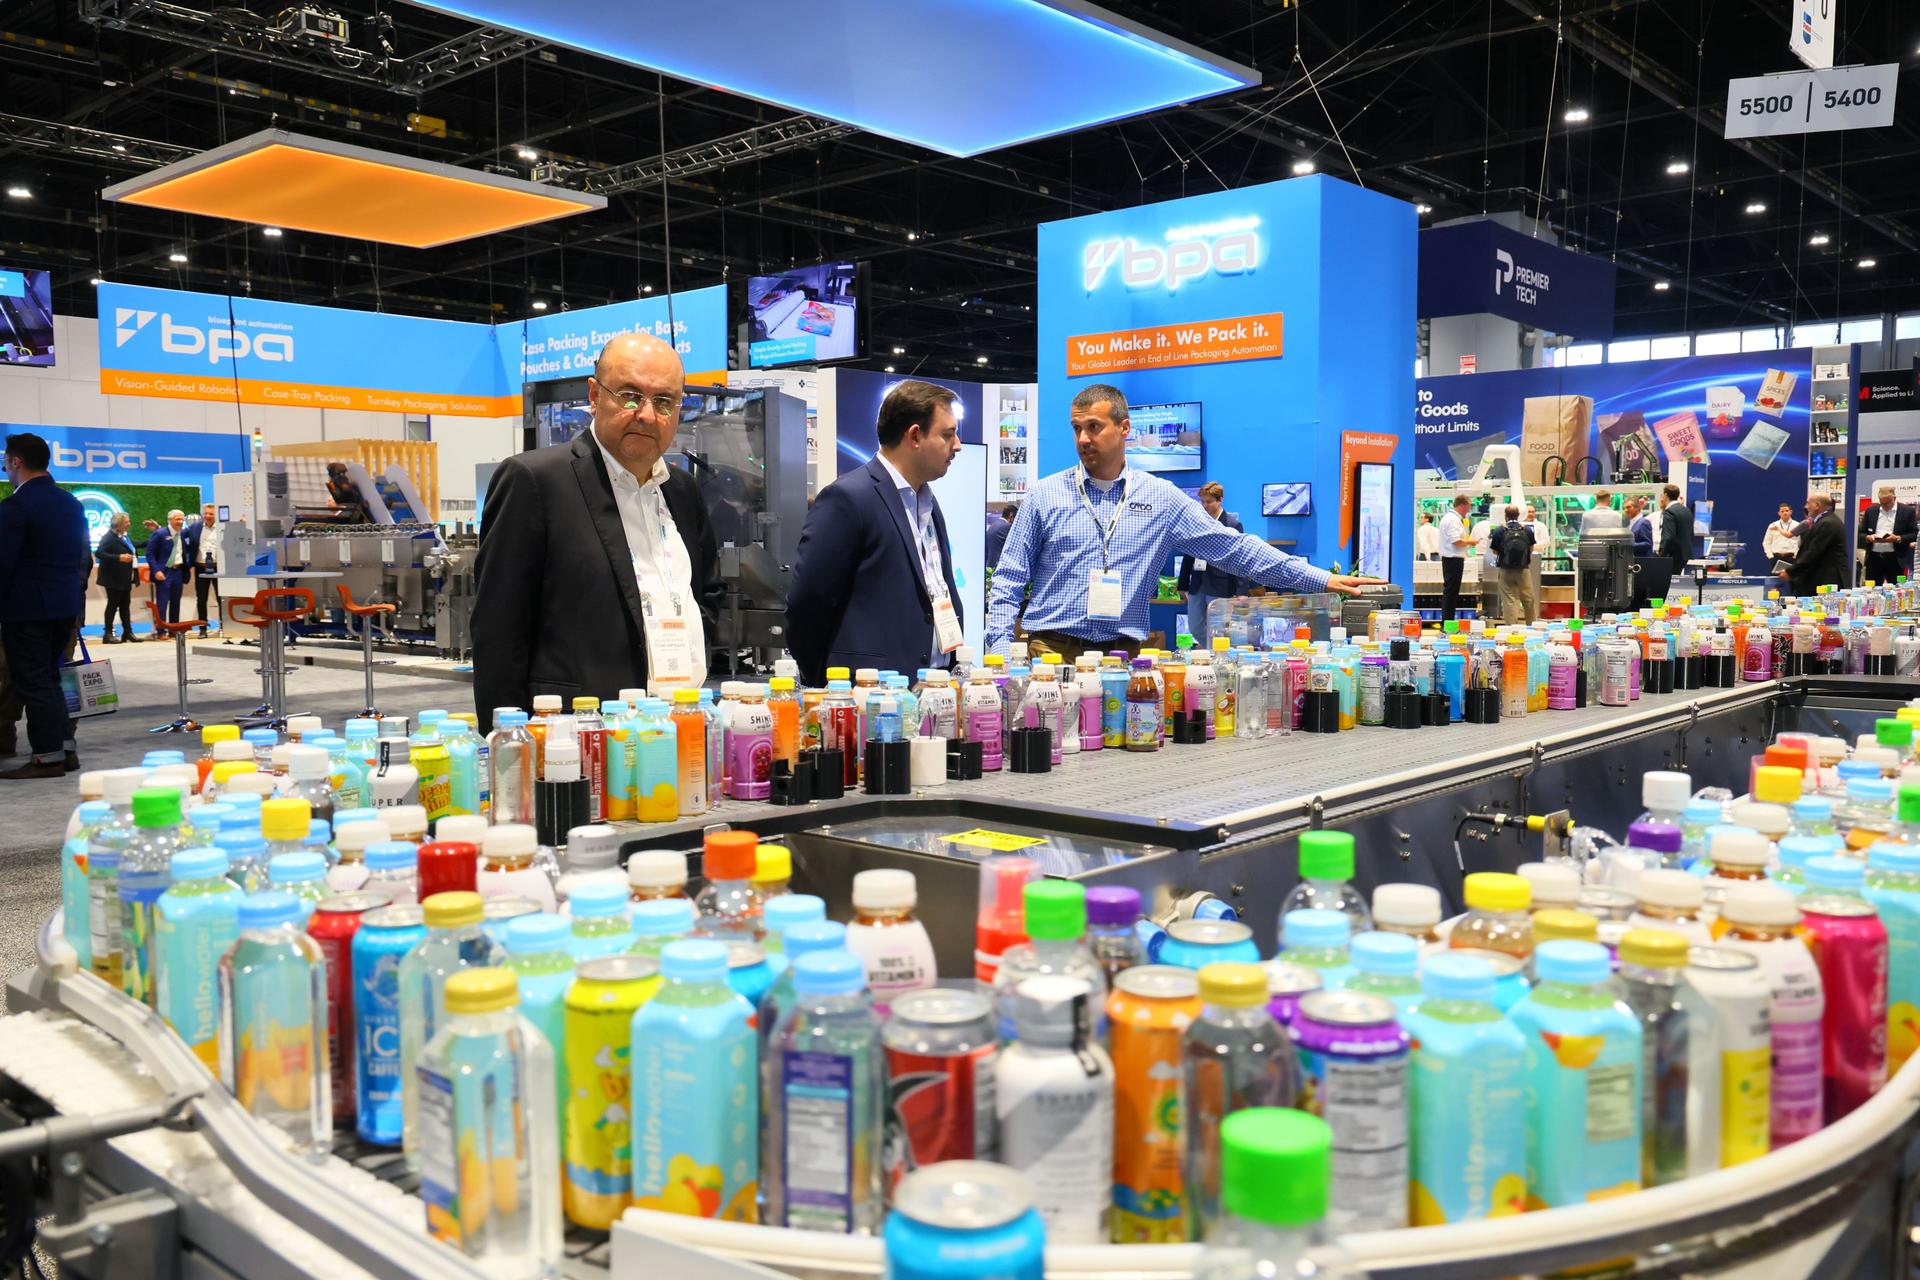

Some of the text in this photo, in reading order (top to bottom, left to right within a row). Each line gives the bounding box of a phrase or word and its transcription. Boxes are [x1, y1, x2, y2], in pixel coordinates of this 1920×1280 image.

[1740, 86, 1881, 116] 5500 5400
[1123, 232, 1257, 288] bpa
[1516, 265, 1550, 291] PREMIER
[1516, 285, 1537, 306] TECH
[208, 315, 293, 331] bluepint automation
[161, 312, 294, 365] bpa
[522, 342, 545, 356] Case
[548, 334, 588, 352] Packing
[591, 328, 632, 346] Expe
[1076, 322, 1269, 356] You Make it. We Pack it.
[520, 359, 560, 376] Pouches
[563, 355, 571, 369] &
[1071, 343, 1277, 371] Your Global Leader in End of Line Packaging Automation
[115, 376, 243, 396] Vision-Guided Robotics
[1417, 389, 1433, 401] to
[1766, 385, 1785, 395] SPICES
[1872, 391, 1898, 399] Applied
[263, 387, 350, 405] Case-Tray Packing
[368, 395, 487, 412] Turnkey Packaging Solutions
[1421, 402, 1468, 417] Goods
[1415, 421, 1480, 434] ithout Limits
[1667, 426, 1692, 441] SWEET
[1345, 434, 1393, 447] Beyond Installation
[1669, 433, 1695, 448] GOODS
[52, 440, 147, 473] bpa
[1342, 451, 1351, 506] Partnership
[83, 672, 101, 680] PACK
[84, 678, 103, 687] EXPO
[370, 798, 404, 807] UPER
[364, 1023, 398, 1057] IC
